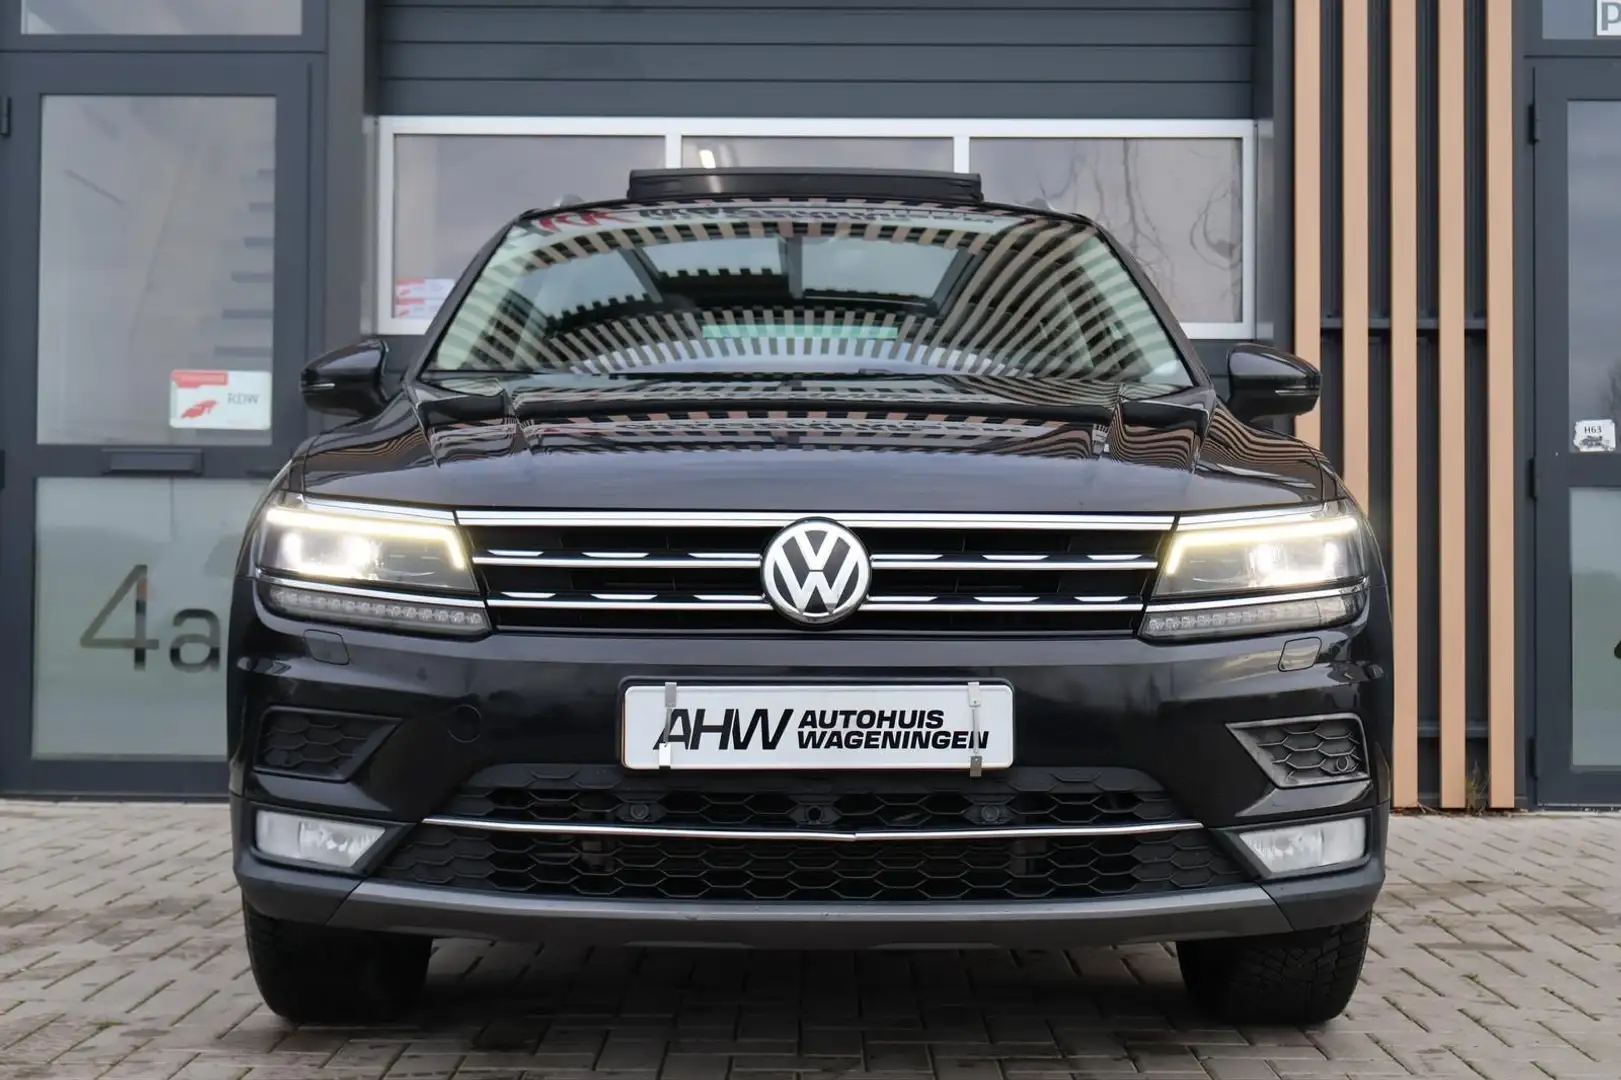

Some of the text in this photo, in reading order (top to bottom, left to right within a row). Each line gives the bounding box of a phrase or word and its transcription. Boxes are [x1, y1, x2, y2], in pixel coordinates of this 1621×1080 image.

[80, 564, 221, 673] 4a
[653, 708, 794, 750] AHW
[797, 709, 945, 729] AUTOHUIS
[797, 730, 990, 750] WAGENINGEN
